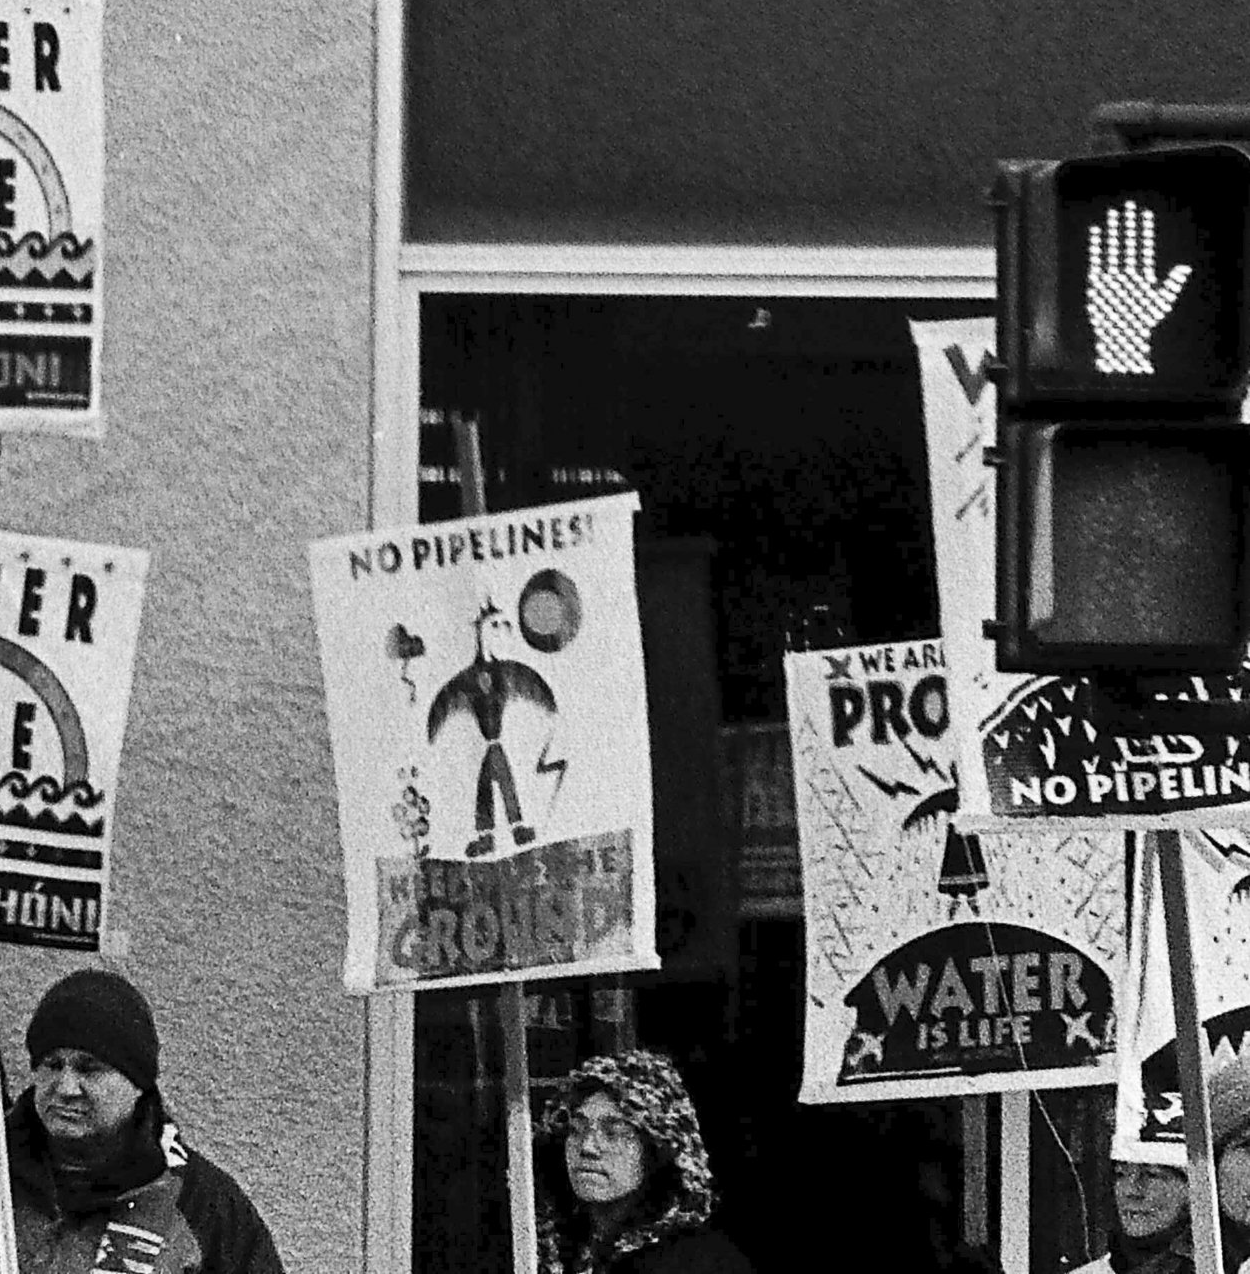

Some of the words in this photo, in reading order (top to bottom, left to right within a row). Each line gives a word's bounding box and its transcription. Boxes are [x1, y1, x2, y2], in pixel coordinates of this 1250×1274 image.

[349, 540, 403, 581] NO
[411, 513, 594, 570] PIPELINES!
[858, 646, 896, 675] WE
[829, 673, 950, 749] PRO
[1011, 774, 1078, 806] NO
[1086, 761, 1250, 804] PIPELIN
[872, 951, 1088, 1027] WATER
[916, 1021, 949, 1051] IS
[959, 1014, 1033, 1048] LIFE
